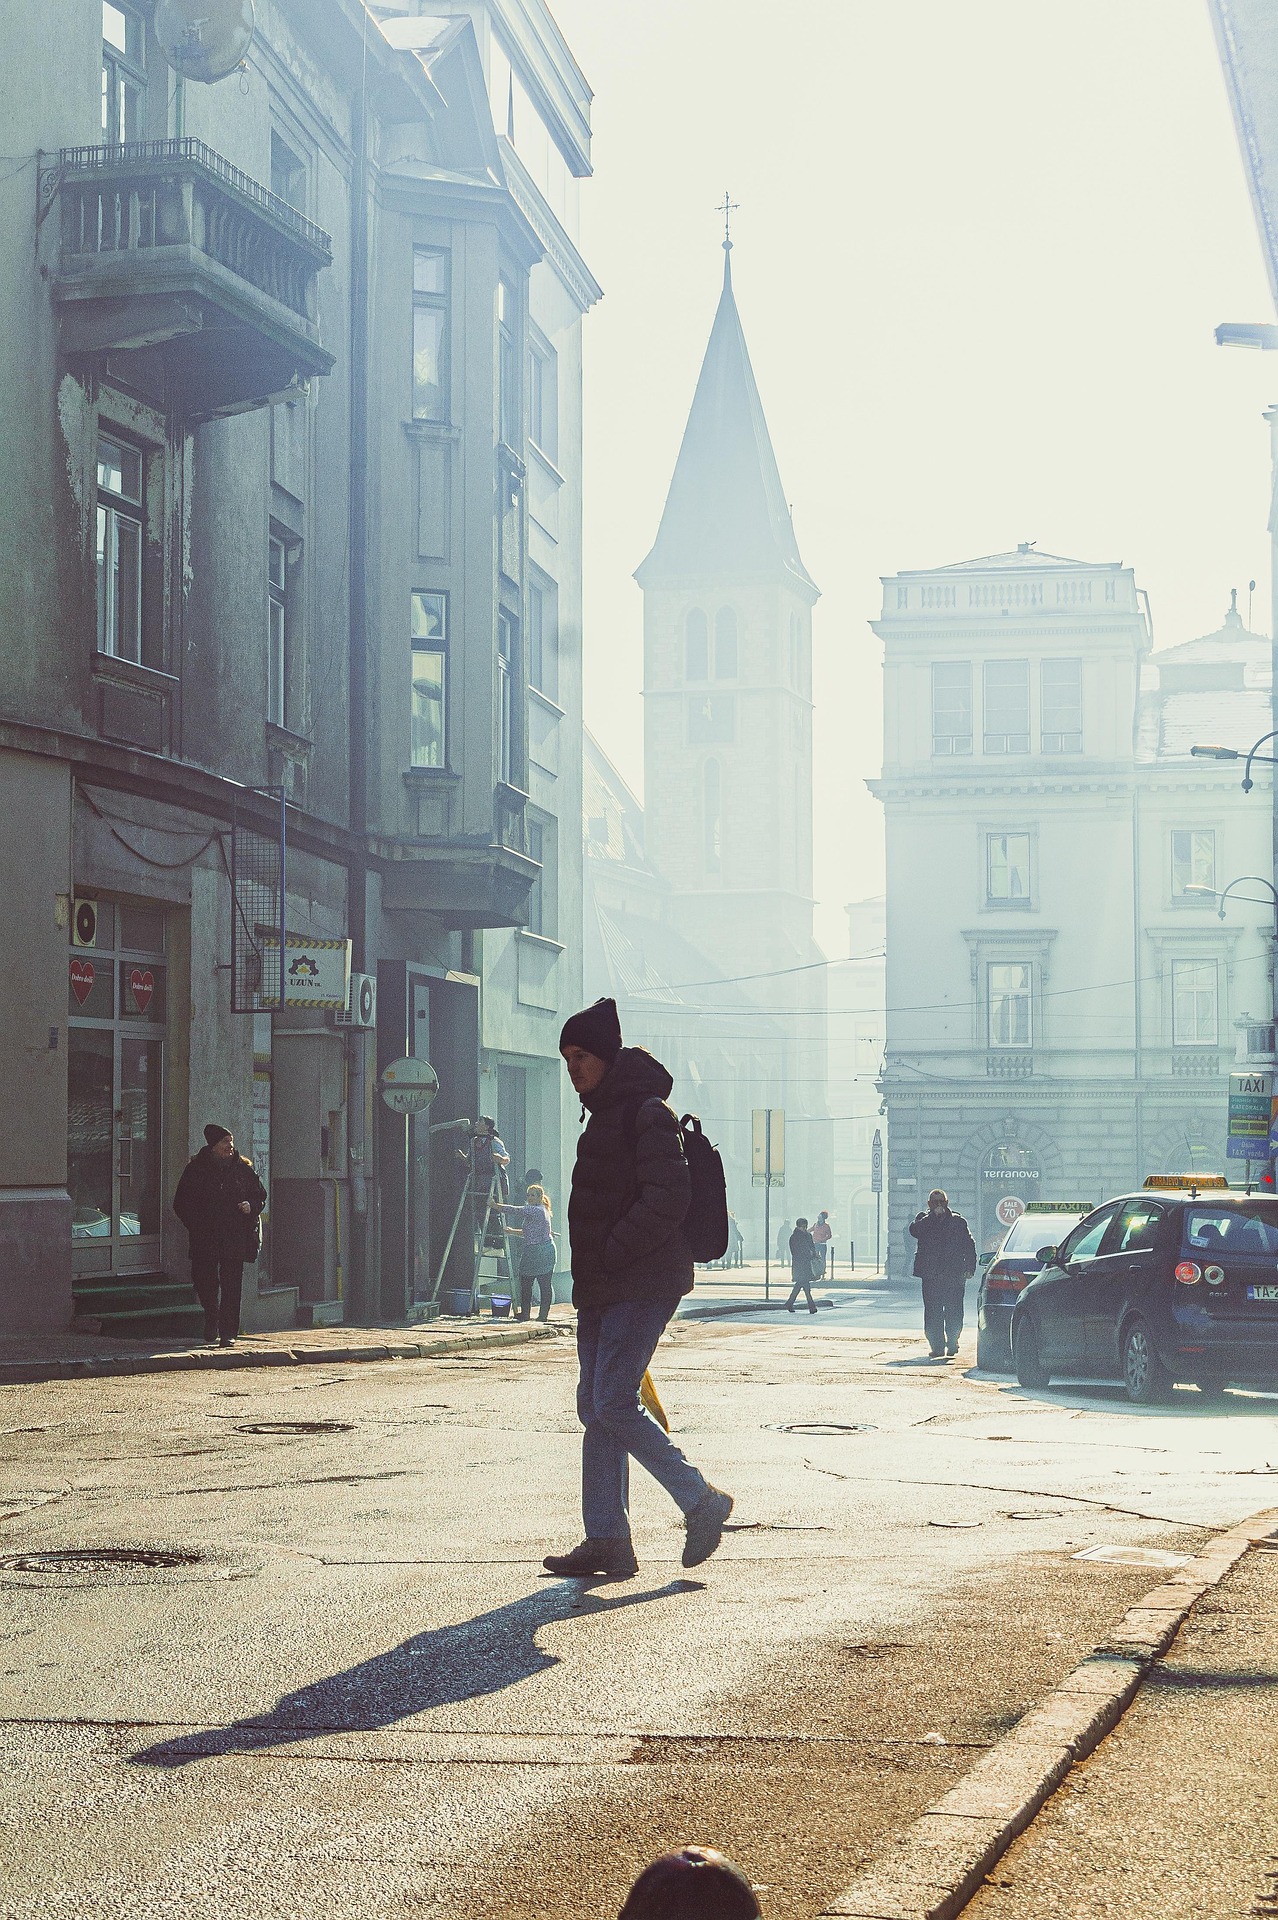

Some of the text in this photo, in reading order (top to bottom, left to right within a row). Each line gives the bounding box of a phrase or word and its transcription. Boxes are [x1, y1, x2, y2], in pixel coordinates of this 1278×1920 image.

[290, 979, 313, 987] UZUN
[1238, 1079, 1265, 1093] TAXI
[1151, 1176, 1179, 1186] SARAJEVO
